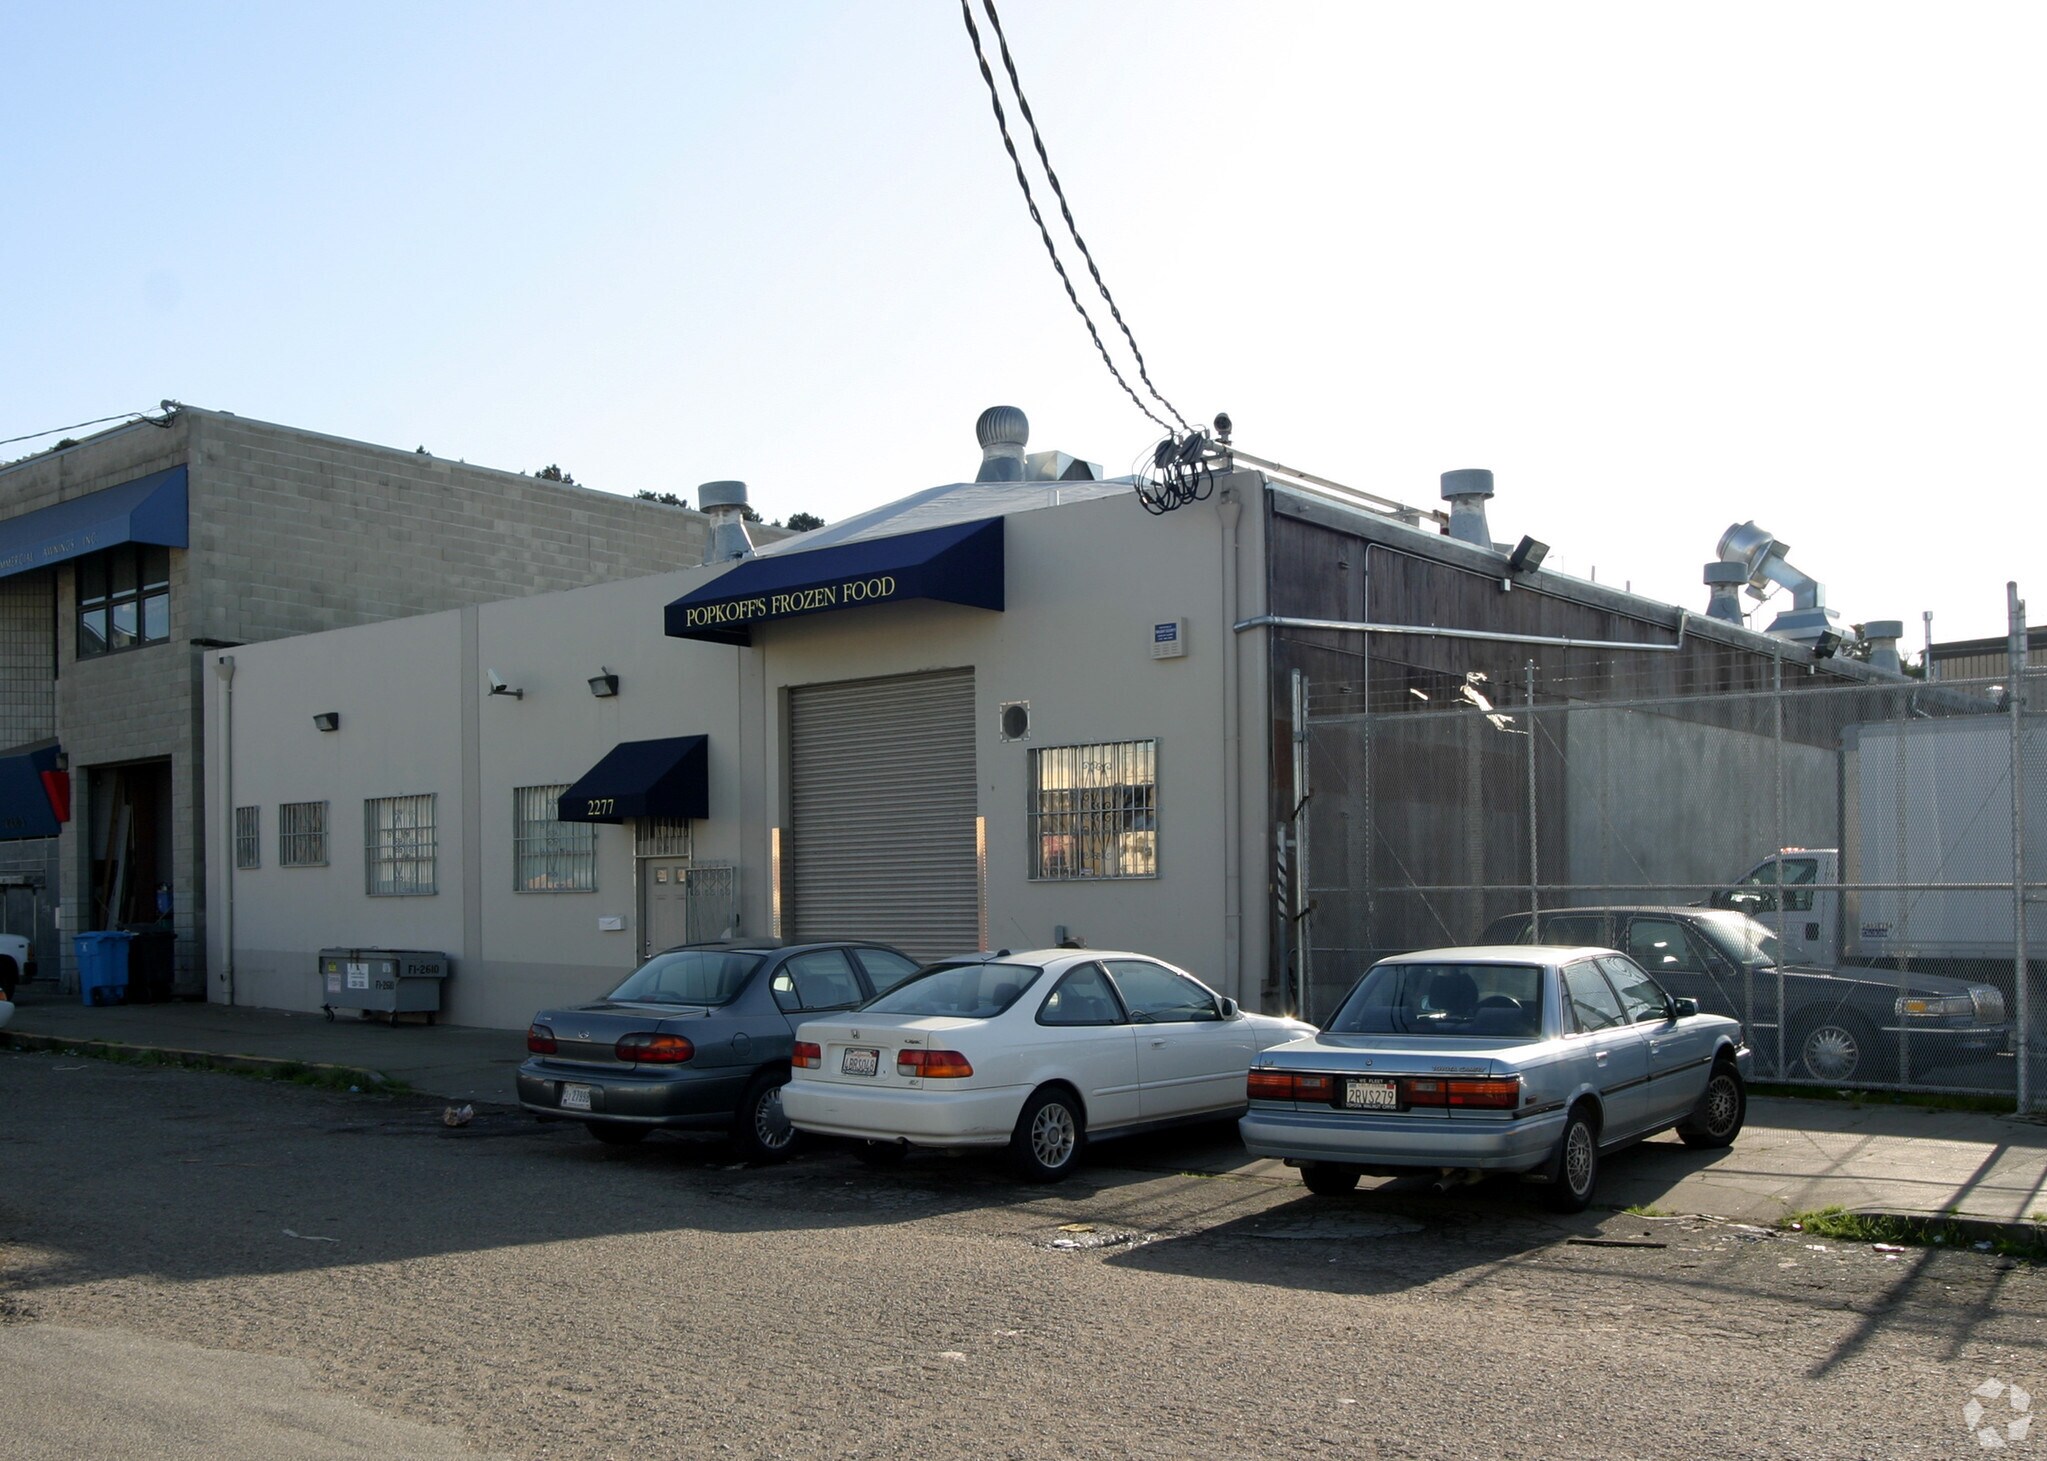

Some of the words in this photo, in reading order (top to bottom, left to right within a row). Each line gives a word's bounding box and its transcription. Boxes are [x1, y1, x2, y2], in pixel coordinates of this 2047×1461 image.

[686, 597, 766, 627] POPKOFF'S
[771, 586, 837, 615] FROZEN
[843, 576, 895, 603] FOOD
[587, 798, 614, 816] 2277
[1348, 1089, 1395, 1105] 2RVS279
